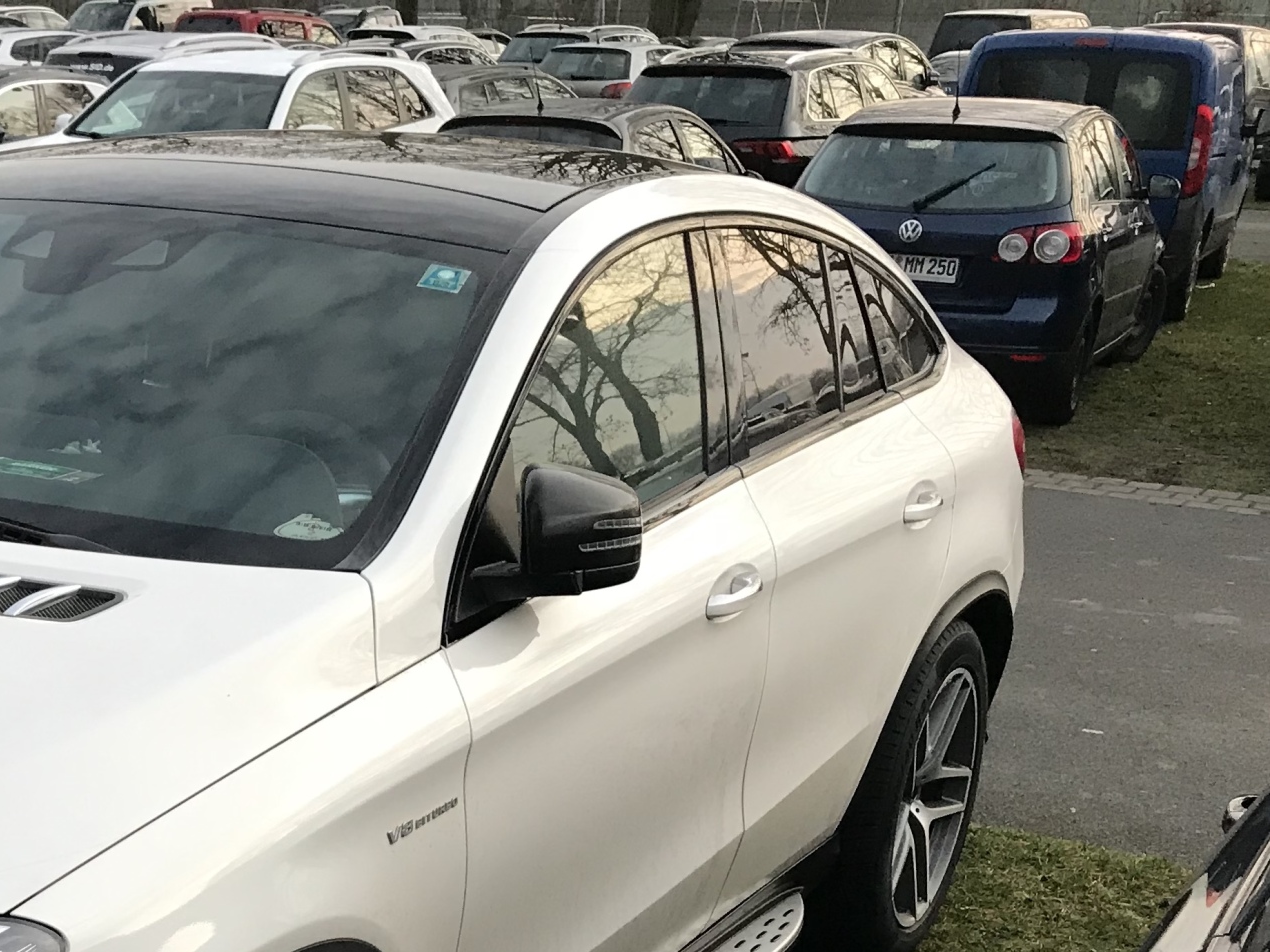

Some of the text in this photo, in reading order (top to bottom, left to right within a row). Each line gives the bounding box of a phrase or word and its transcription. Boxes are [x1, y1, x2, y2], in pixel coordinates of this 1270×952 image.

[903, 256, 957, 277] MM 250
[386, 819, 414, 846] V8
